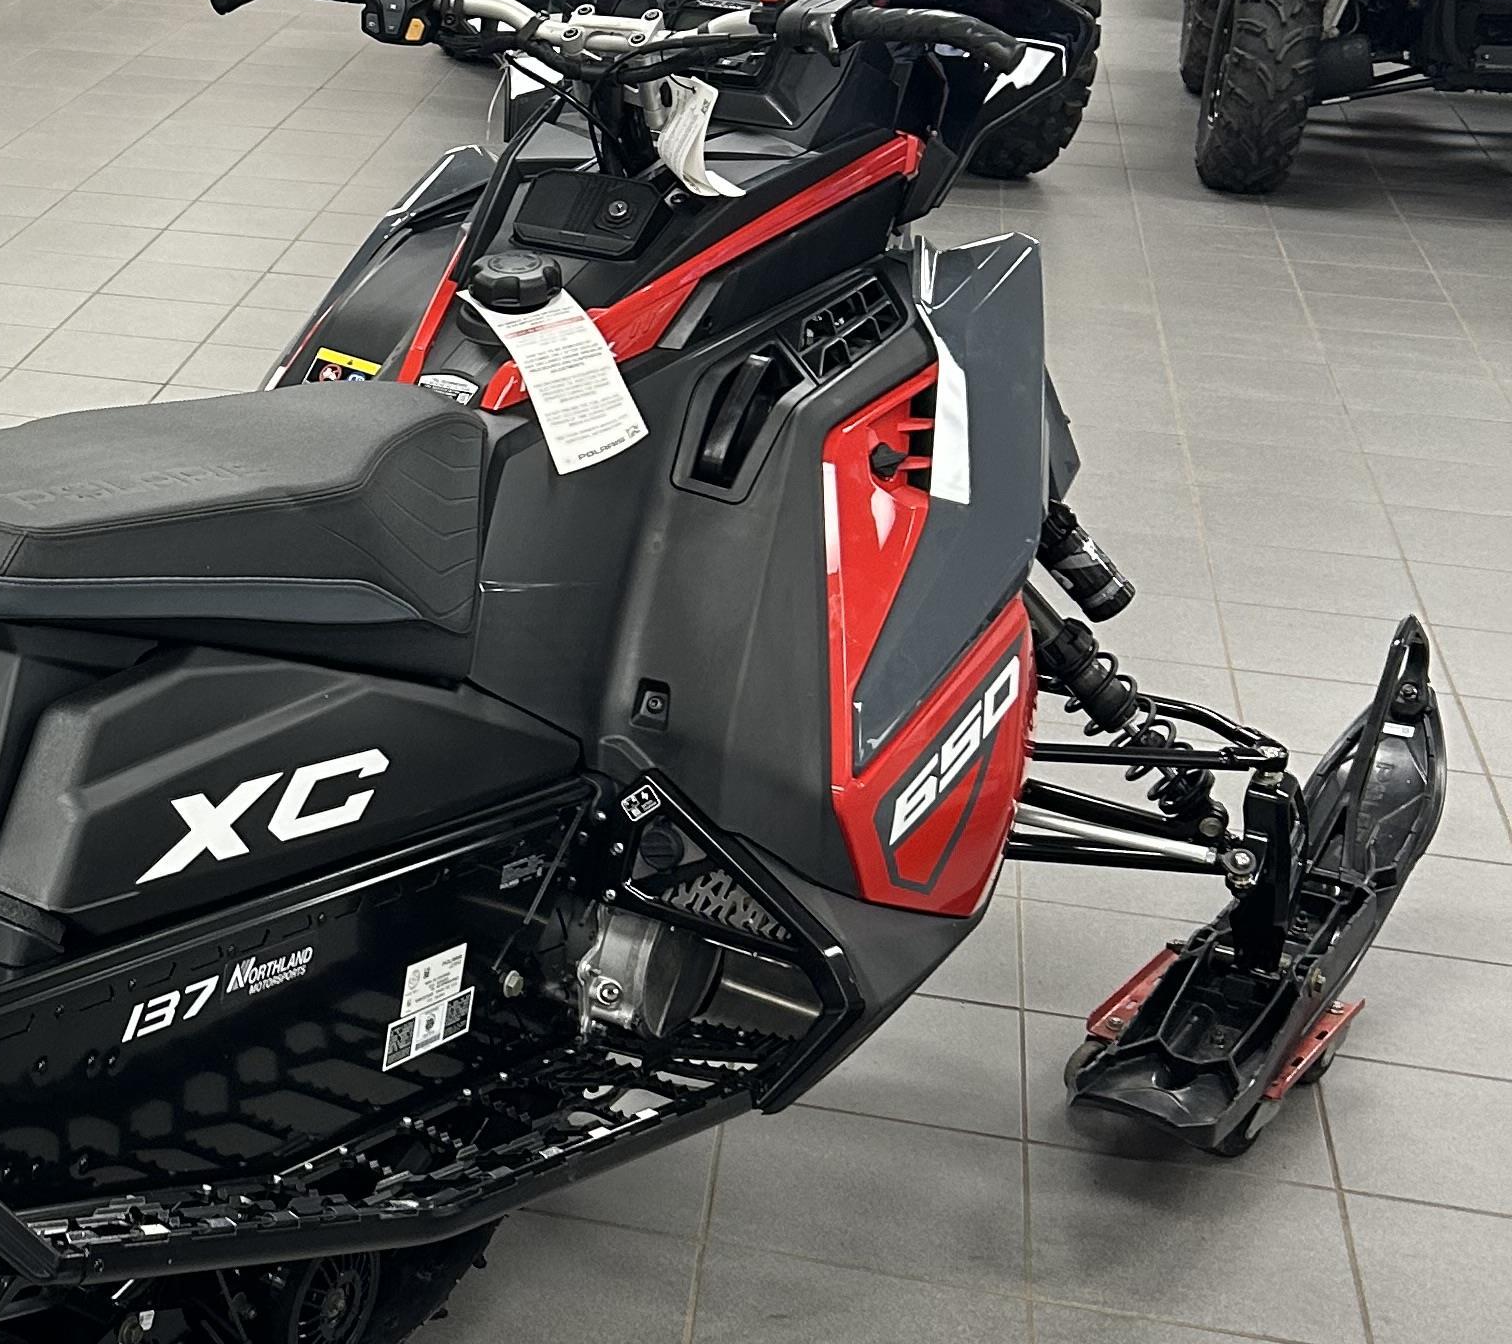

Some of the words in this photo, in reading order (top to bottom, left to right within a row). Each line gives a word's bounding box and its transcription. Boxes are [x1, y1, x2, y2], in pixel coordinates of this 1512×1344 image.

[578, 436, 627, 461] POLARIS
[889, 655, 1020, 846] 650
[136, 748, 389, 885] XC
[121, 975, 220, 1044] 137
[248, 964, 307, 996] MOTORSPORTS
